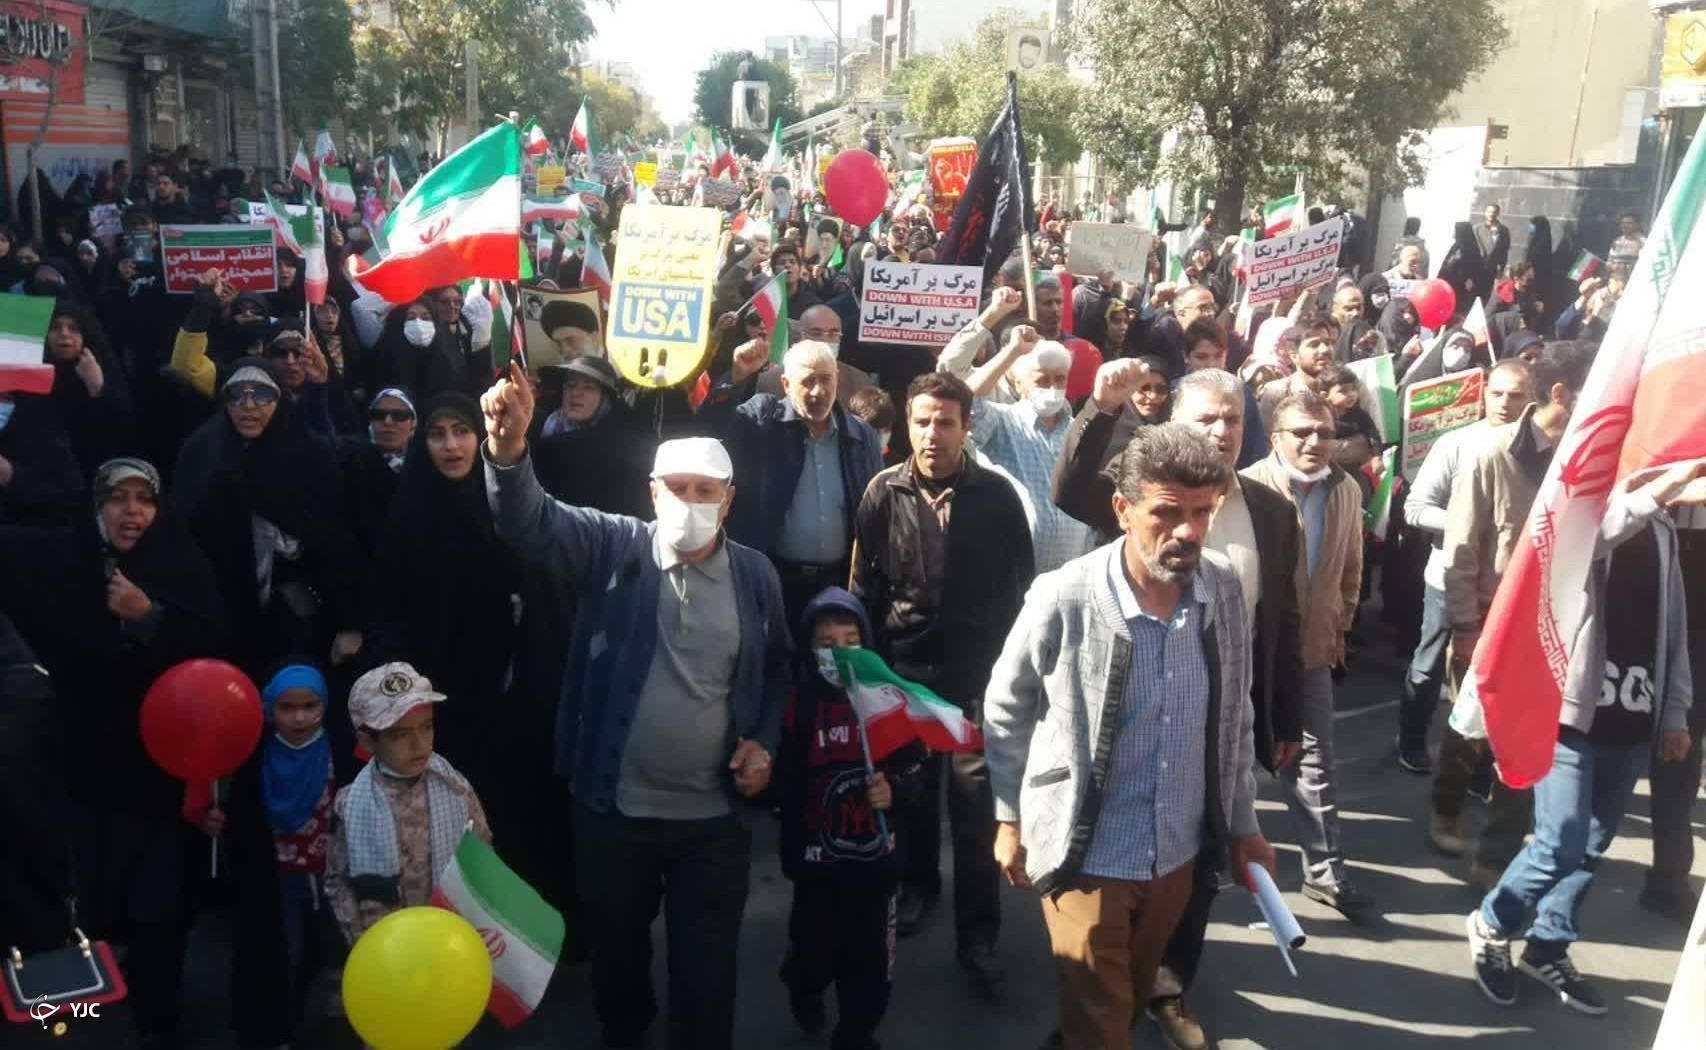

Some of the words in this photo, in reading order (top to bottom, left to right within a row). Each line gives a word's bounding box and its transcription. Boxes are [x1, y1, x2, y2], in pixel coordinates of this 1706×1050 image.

[1298, 238, 1309, 252] بر
[1313, 230, 1339, 245] مرگ
[1254, 236, 1295, 258] آمریکا
[167, 249, 225, 265] اسلامی
[228, 247, 272, 264] انقلاب
[1299, 268, 1310, 281] بر
[1312, 259, 1335, 274] مرگ
[870, 266, 921, 291] آمریکا
[922, 277, 938, 292] بر
[943, 272, 977, 294] مرگ
[664, 288, 697, 302] WITH
[868, 290, 908, 304] DOWN
[910, 293, 941, 306] WITH
[621, 297, 693, 339] USA
[864, 304, 921, 327] اسرائیل
[922, 315, 938, 330] بر
[863, 326, 900, 339] DOWN
[901, 330, 933, 342] WITH
[934, 332, 953, 344] ISR
